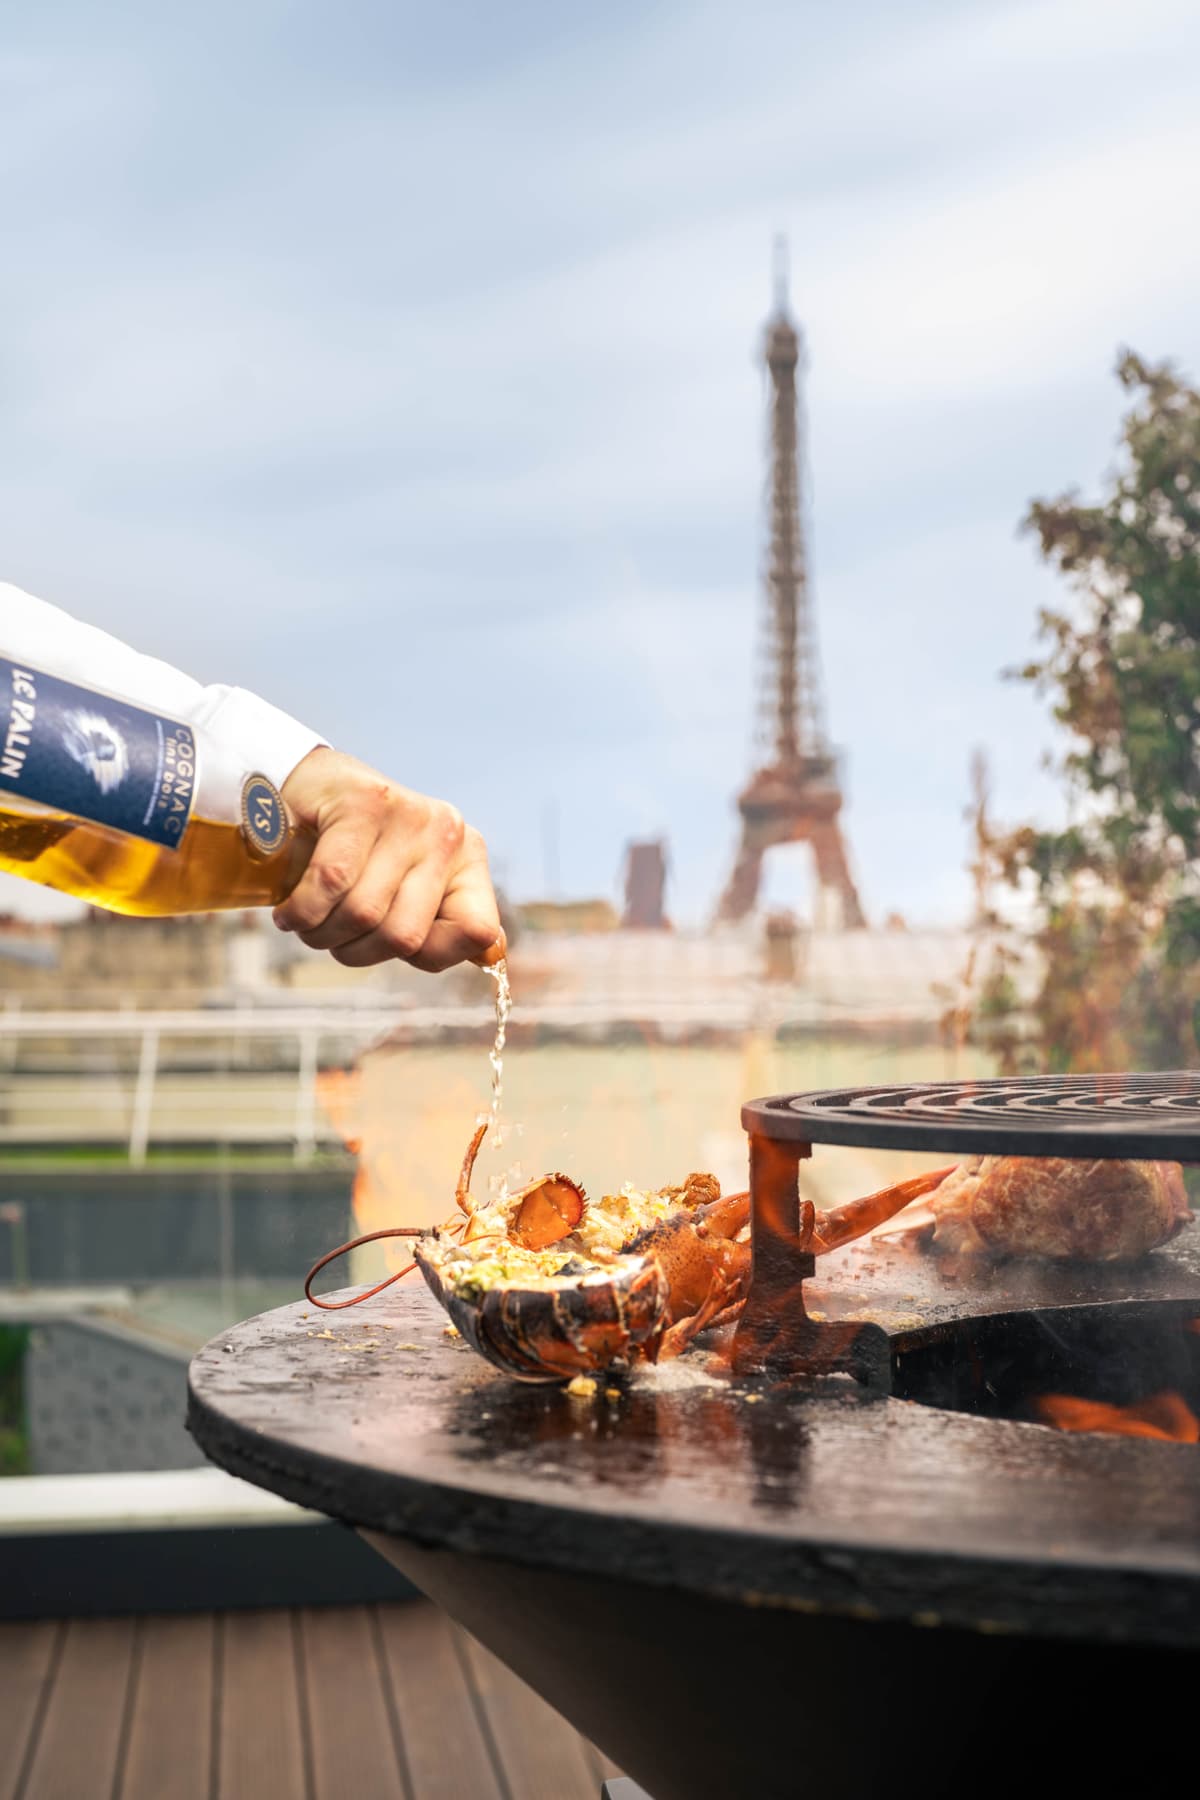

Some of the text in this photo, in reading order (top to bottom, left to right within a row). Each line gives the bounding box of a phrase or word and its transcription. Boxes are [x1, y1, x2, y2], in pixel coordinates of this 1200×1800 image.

[0, 699, 36, 778] PALIN
[164, 729, 194, 833] COGNAC
[255, 797, 273, 833] VS
